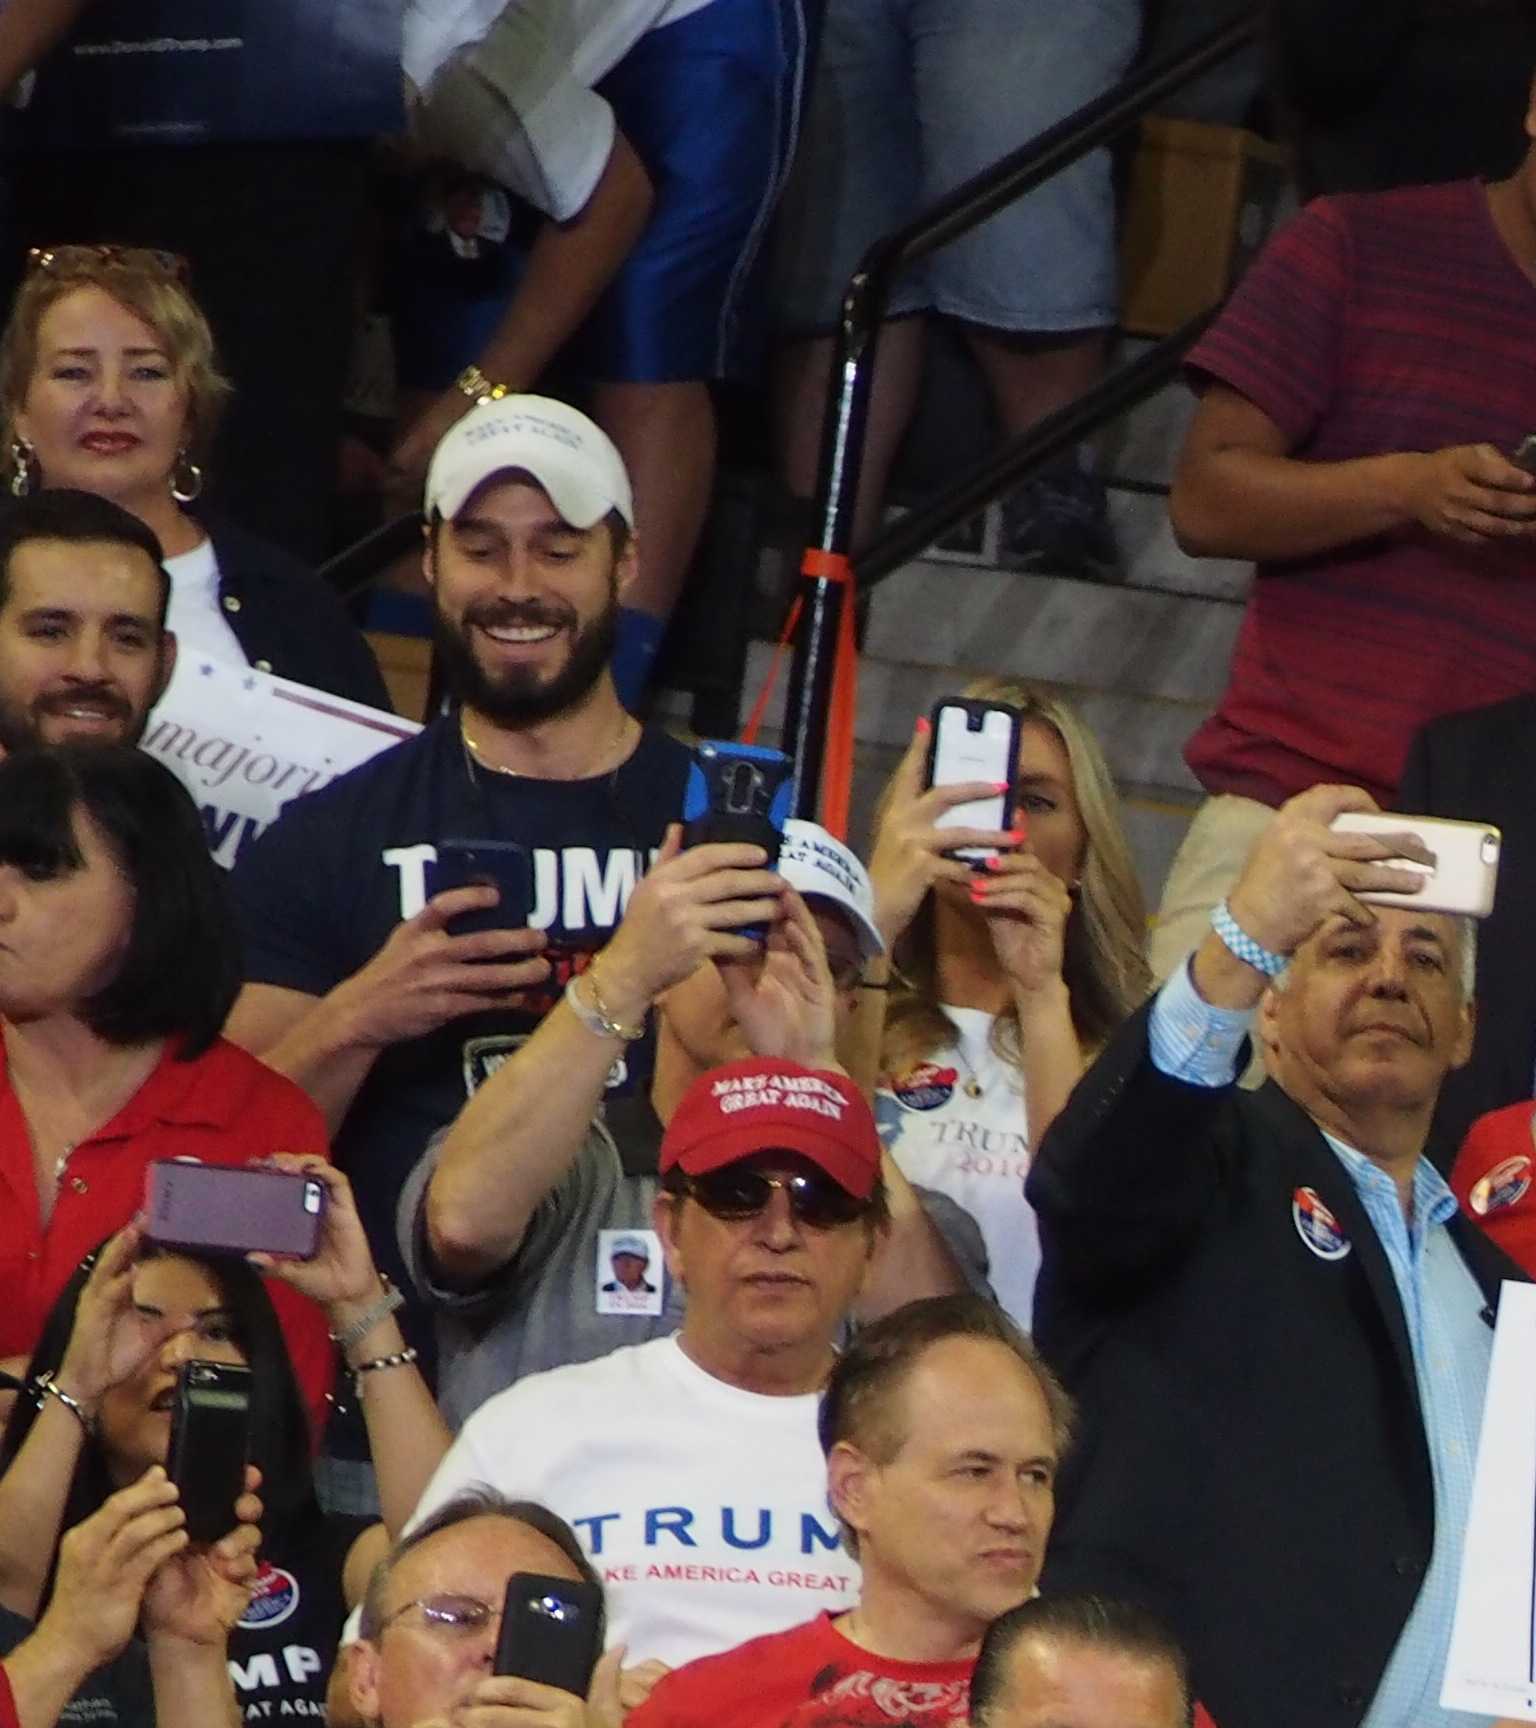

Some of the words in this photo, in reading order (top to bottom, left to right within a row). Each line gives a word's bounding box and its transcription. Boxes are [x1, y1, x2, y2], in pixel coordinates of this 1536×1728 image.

[145, 720, 334, 792] majori
[711, 1074, 768, 1097] MAKE
[768, 1075, 850, 1105] AMERICA
[720, 1088, 782, 1114] GREAT
[782, 1092, 841, 1120] AGAIN
[930, 1119, 1029, 1153] TRU
[574, 1505, 842, 1555] TRUM
[605, 1564, 637, 1582] KE
[646, 1563, 760, 1585] AMERICA
[768, 1570, 850, 1593] GREAT
